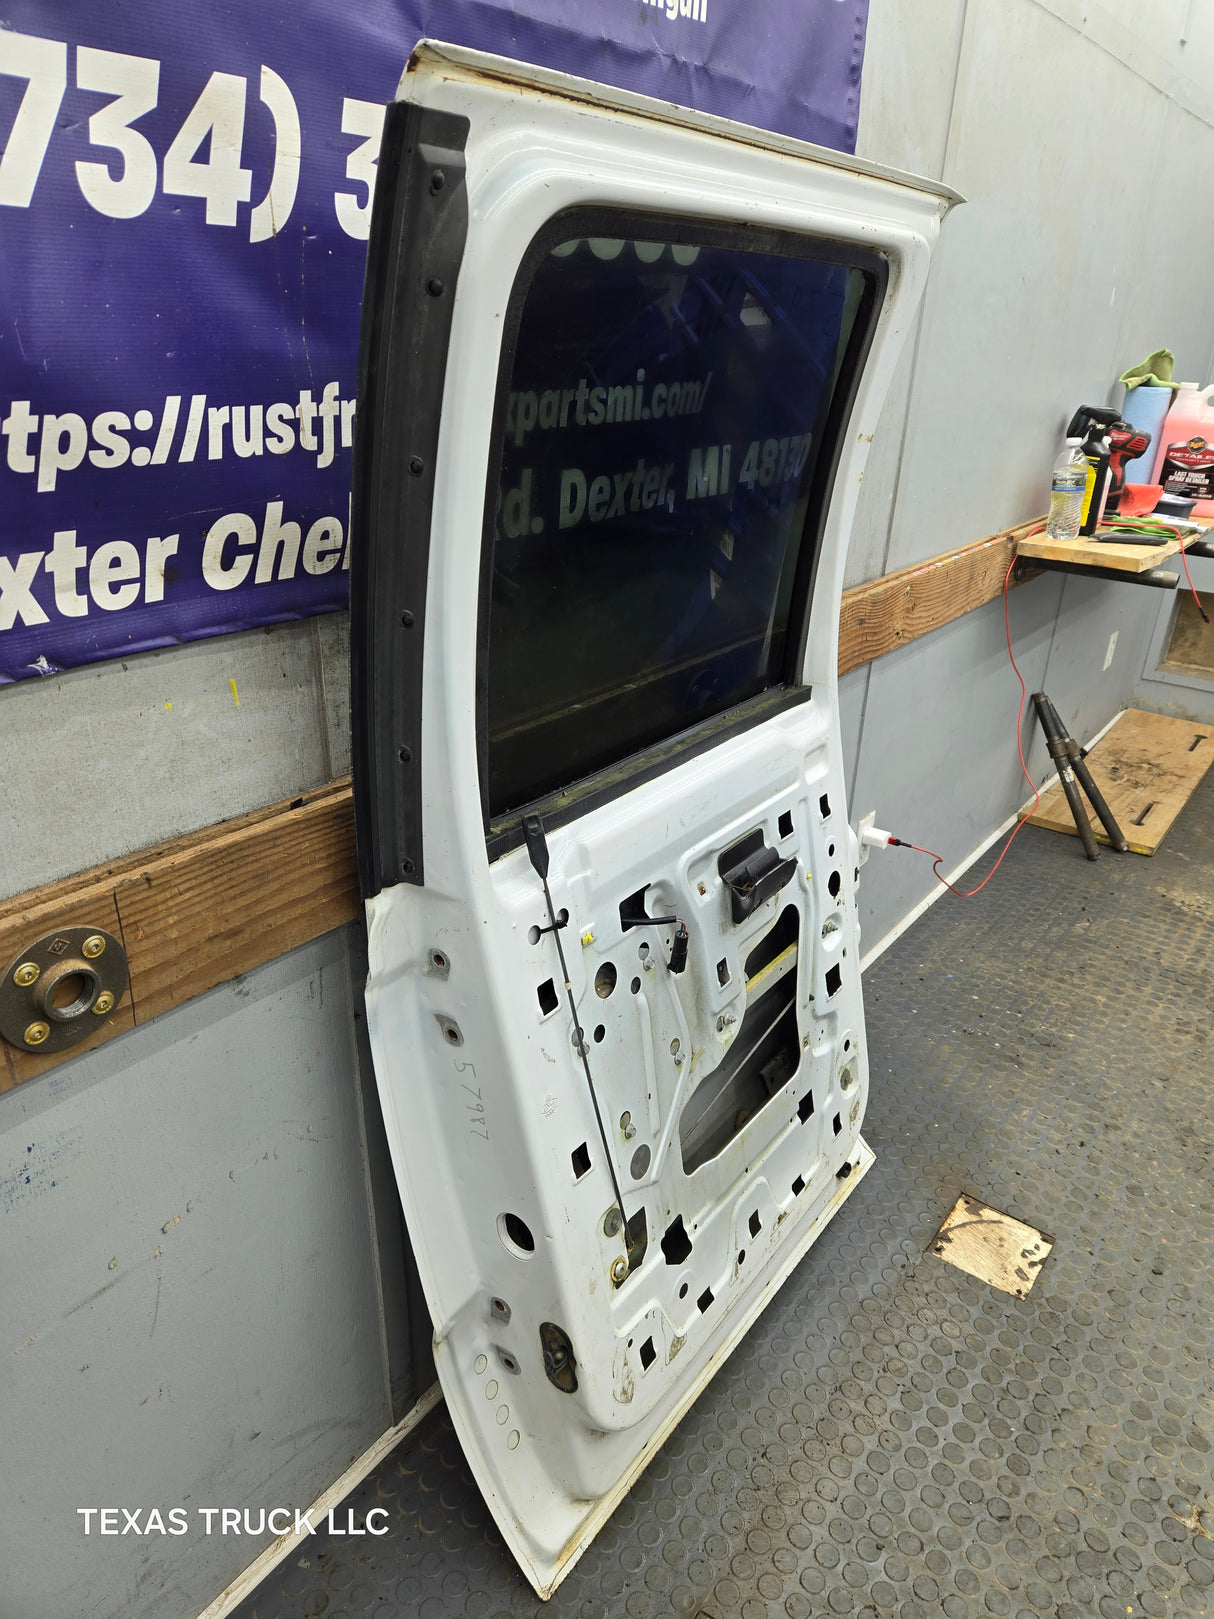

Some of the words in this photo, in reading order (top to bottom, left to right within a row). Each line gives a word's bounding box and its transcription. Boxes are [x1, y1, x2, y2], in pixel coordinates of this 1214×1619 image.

[496, 468, 544, 541] d.
[559, 458, 676, 529] Dexter,
[686, 444, 732, 501] MI
[0, 529, 180, 631] xter
[202, 492, 353, 591] Che
